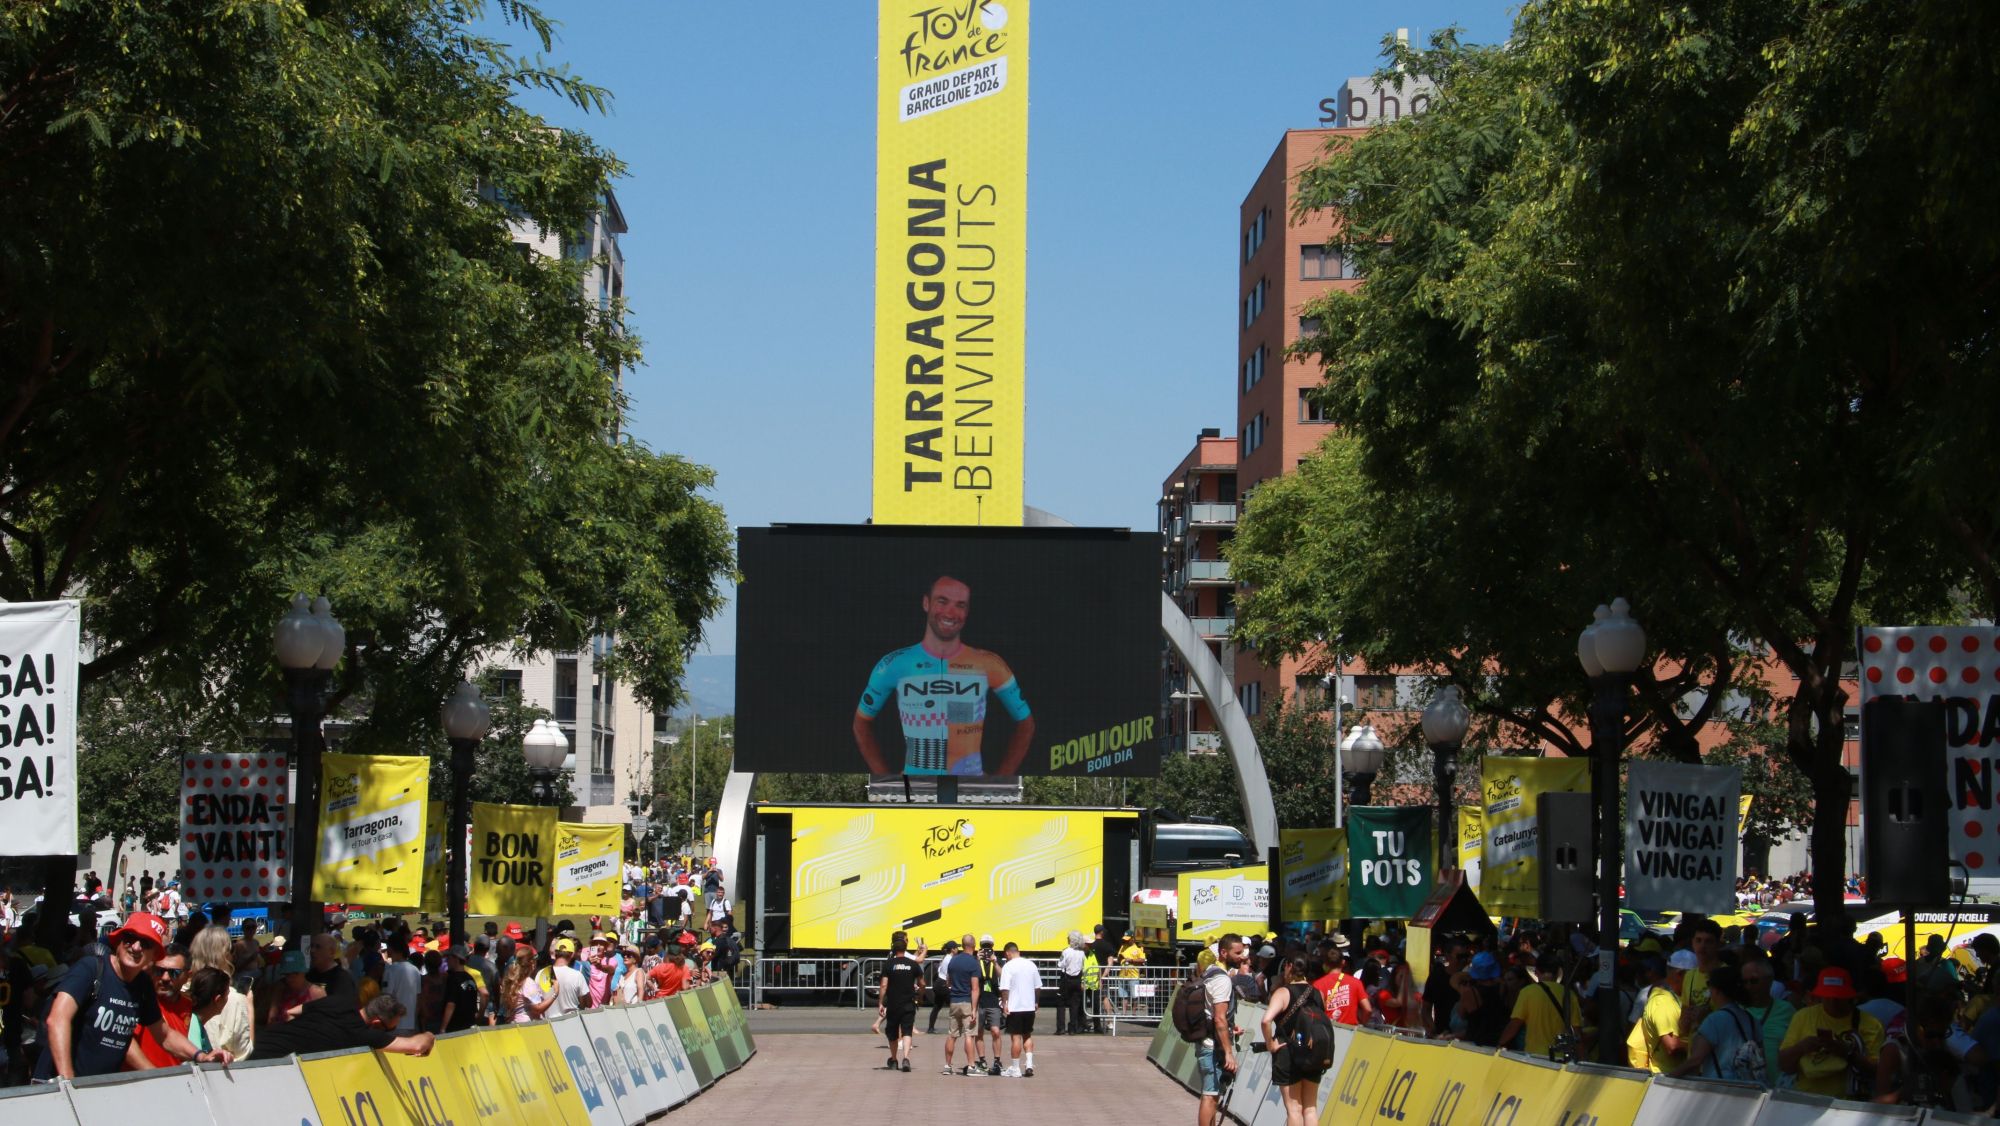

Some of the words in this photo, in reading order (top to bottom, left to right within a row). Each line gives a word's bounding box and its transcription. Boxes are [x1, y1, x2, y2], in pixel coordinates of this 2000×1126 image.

[967, 24, 982, 39] de
[906, 86, 971, 116] BARCELONE
[974, 77, 1000, 96] 2026
[909, 78, 950, 101] GRAND
[904, 158, 947, 492] TARRAGONA
[953, 183, 997, 490] BENVINGUTS
[1050, 715, 1154, 771] BONJOUR
[1087, 755, 1112, 773] BON
[1114, 748, 1134, 765] DIA
[192, 793, 285, 826] ENDA-
[1640, 790, 1726, 821] VINGA!
[344, 815, 403, 840] Tarragona,
[1638, 820, 1724, 850] VINGA!
[195, 830, 284, 863] VANT!
[358, 838, 371, 847] Tour
[486, 831, 539, 859] BON
[1372, 830, 1405, 857] TU
[479, 859, 545, 887] TOUR
[569, 859, 609, 877] Tarragona,
[1360, 858, 1422, 887] POTS
[1636, 850, 1722, 881] VINGA!
[1914, 912, 1948, 923] OUTIQUE
[1948, 912, 1989, 923] OFICIELLE
[94, 1006, 114, 1031] 10
[1379, 1068, 1418, 1122] LCL
